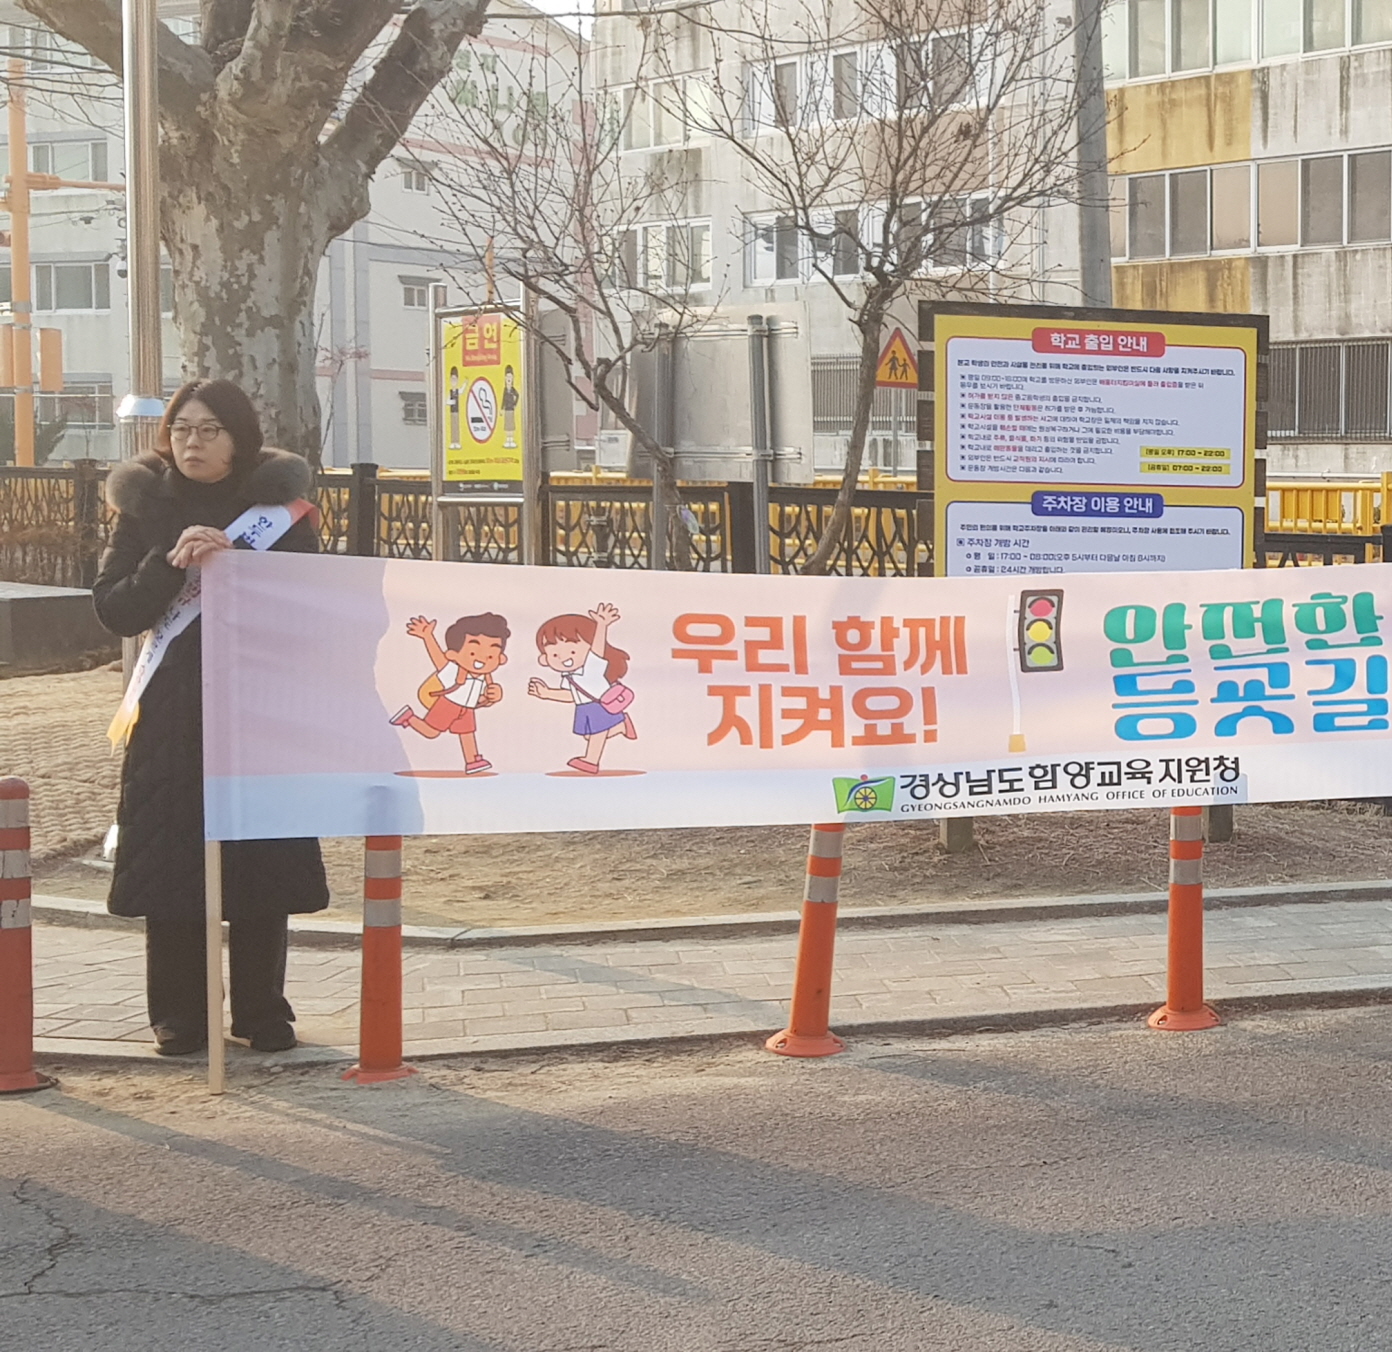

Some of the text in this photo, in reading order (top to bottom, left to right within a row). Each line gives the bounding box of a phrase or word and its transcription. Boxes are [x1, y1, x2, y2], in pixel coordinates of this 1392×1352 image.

[1050, 333, 1147, 352] 학교 출입 안내
[1042, 495, 1152, 513] 주차장 이용 안내
[671, 613, 968, 677] 우리 함께
[1104, 591, 1383, 668] 안전한
[706, 685, 938, 749] 지켜요!
[1111, 654, 1389, 741] 등굣길
[900, 785, 1238, 813] GYEONGSANGNAMDO HAMYANG OFFICE OF EDUCATION
